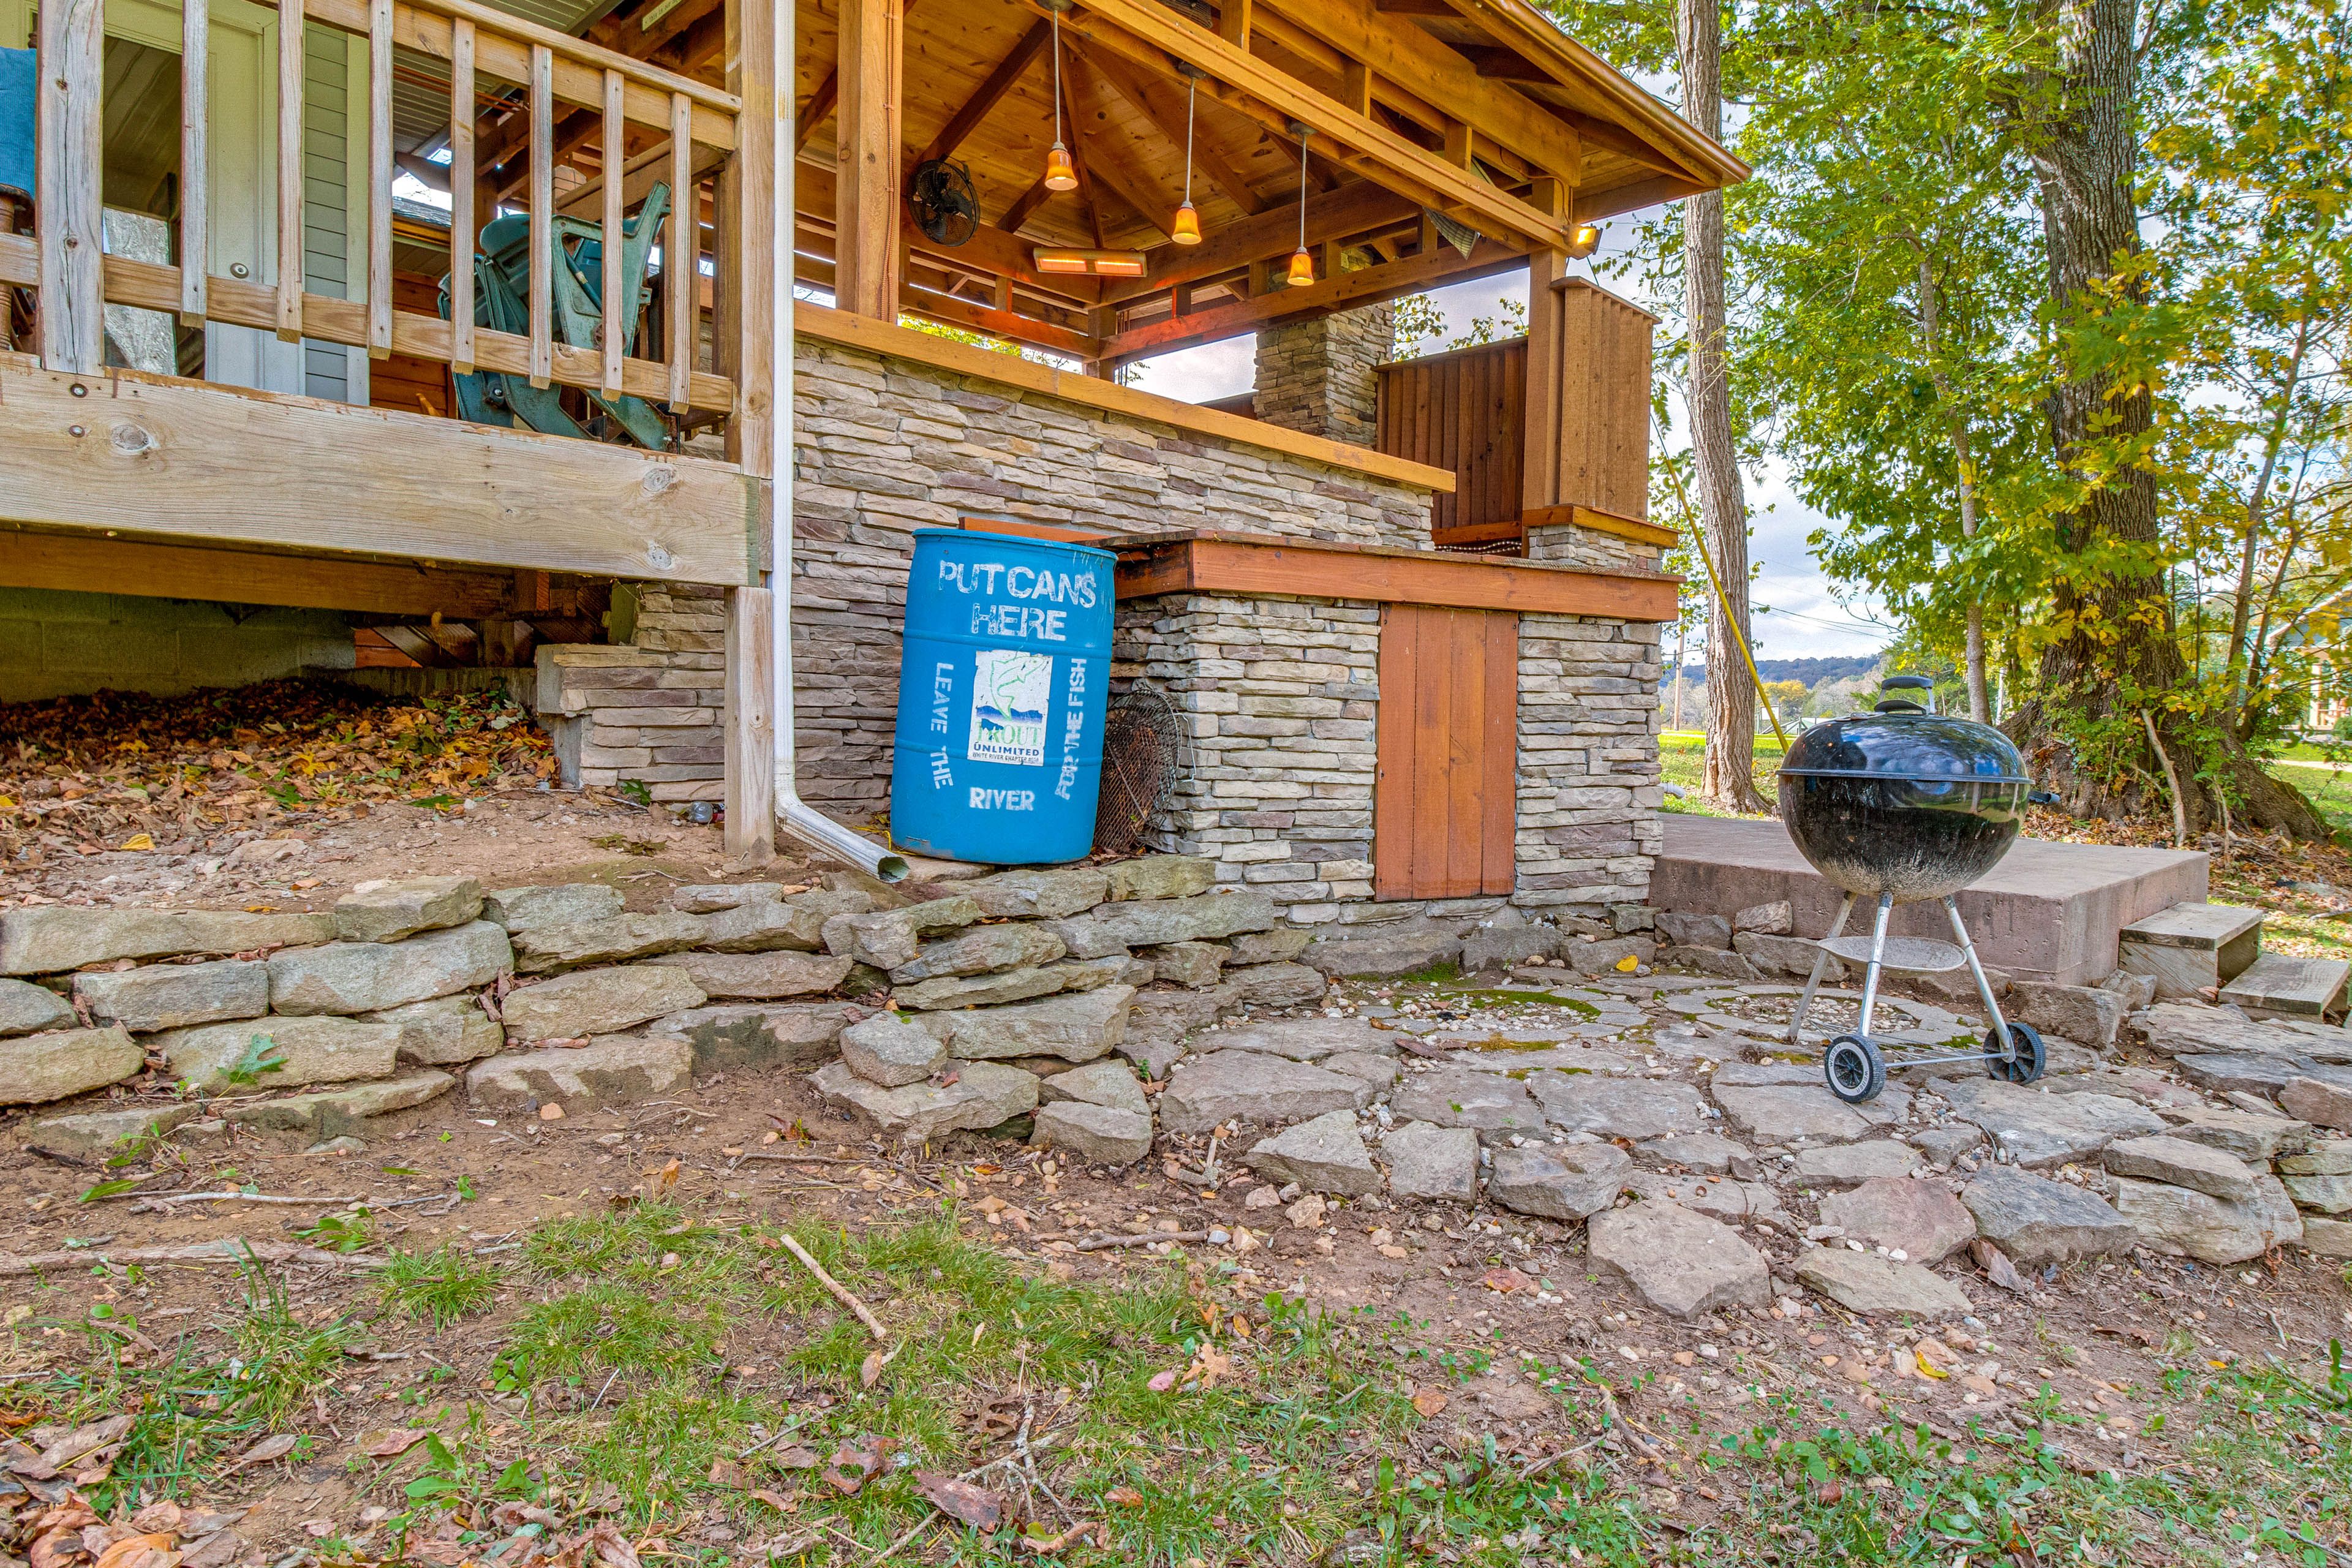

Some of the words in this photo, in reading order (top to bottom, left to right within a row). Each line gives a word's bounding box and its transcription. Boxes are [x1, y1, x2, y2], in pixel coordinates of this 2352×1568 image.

[939, 560, 1005, 595] PUT
[1007, 565, 1096, 608] CANS
[971, 603, 1067, 641] HERE
[930, 662, 954, 734] LEAVE
[1068, 658, 1087, 707] FISH
[974, 742, 1040, 756] UNLIMITED
[1064, 710, 1084, 753] THE
[930, 745, 954, 790] THE
[1054, 755, 1079, 801] FOR
[969, 786, 1036, 811] RIVER
[1828, 1044, 1842, 1068] WEBER
[1856, 1071, 1869, 1093] WEBER
